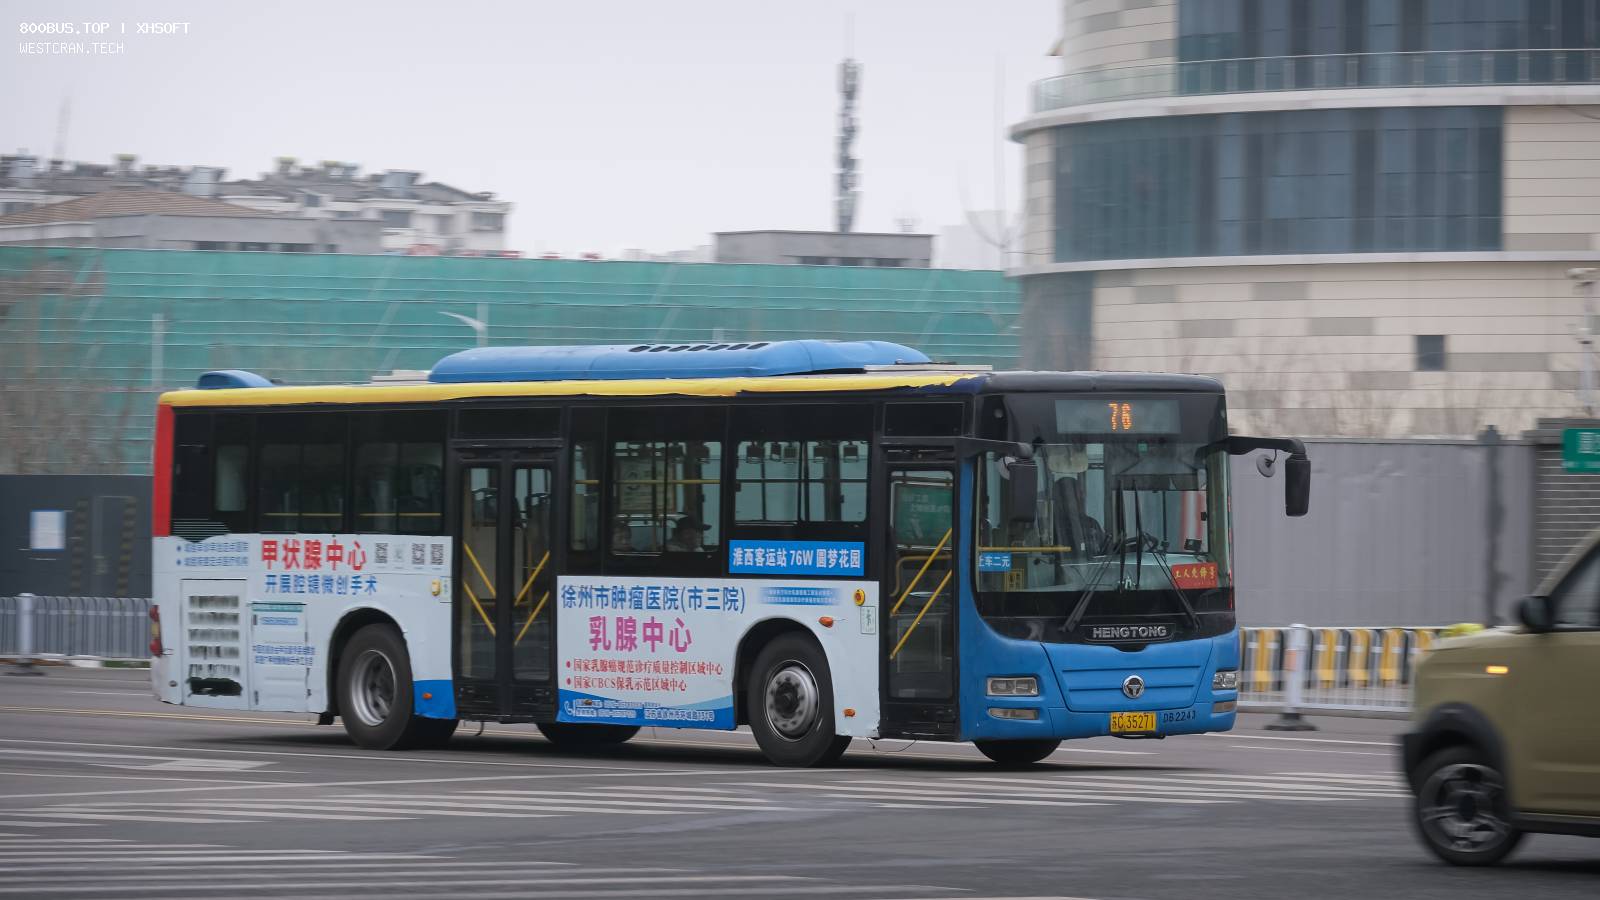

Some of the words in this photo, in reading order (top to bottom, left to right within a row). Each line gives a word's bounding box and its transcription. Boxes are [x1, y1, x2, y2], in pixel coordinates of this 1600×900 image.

[262, 539, 367, 571] 甲状腺中心
[733, 547, 787, 567] 淮西客运站
[790, 550, 814, 566] 76W
[265, 574, 377, 595] 开展腔镜微创手术
[588, 615, 692, 653] 乳腺中心
[1093, 626, 1167, 638] HENGTONG
